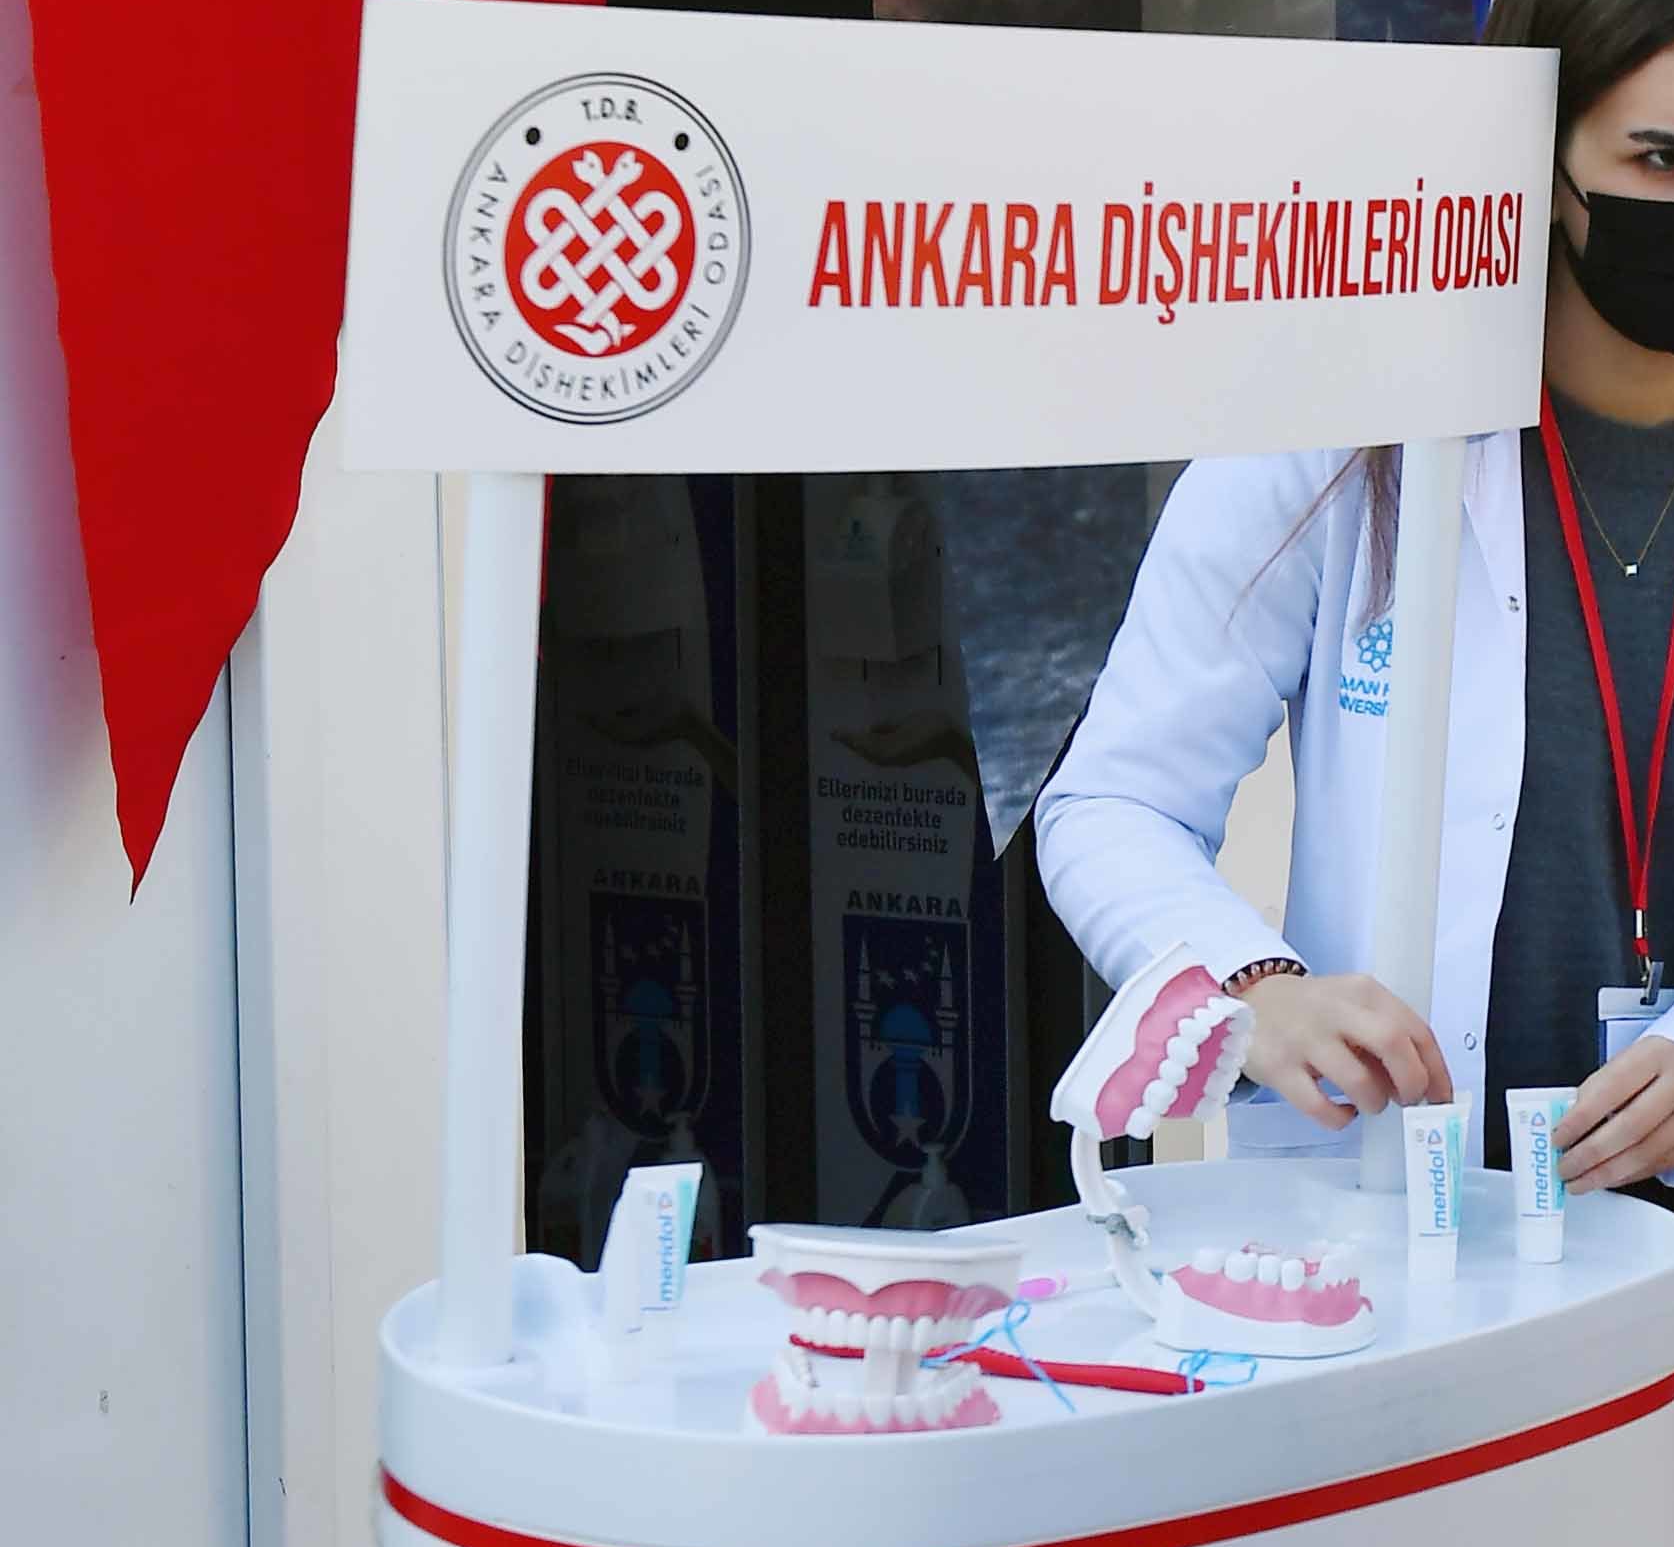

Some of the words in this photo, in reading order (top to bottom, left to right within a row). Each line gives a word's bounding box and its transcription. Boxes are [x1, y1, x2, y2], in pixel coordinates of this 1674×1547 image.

[580, 96, 645, 125] T.D.B.
[467, 161, 509, 331] ANKARA
[694, 164, 730, 286] ODASI
[807, 199, 1078, 309] ANKARA
[1098, 177, 1425, 326] DİŞHEKİMLERİ
[1432, 191, 1525, 293] ODASI
[903, 782, 967, 807] burada
[847, 889, 962, 918] ANKARA
[1428, 1149, 1448, 1229] meridol
[1530, 1131, 1549, 1211] meridol
